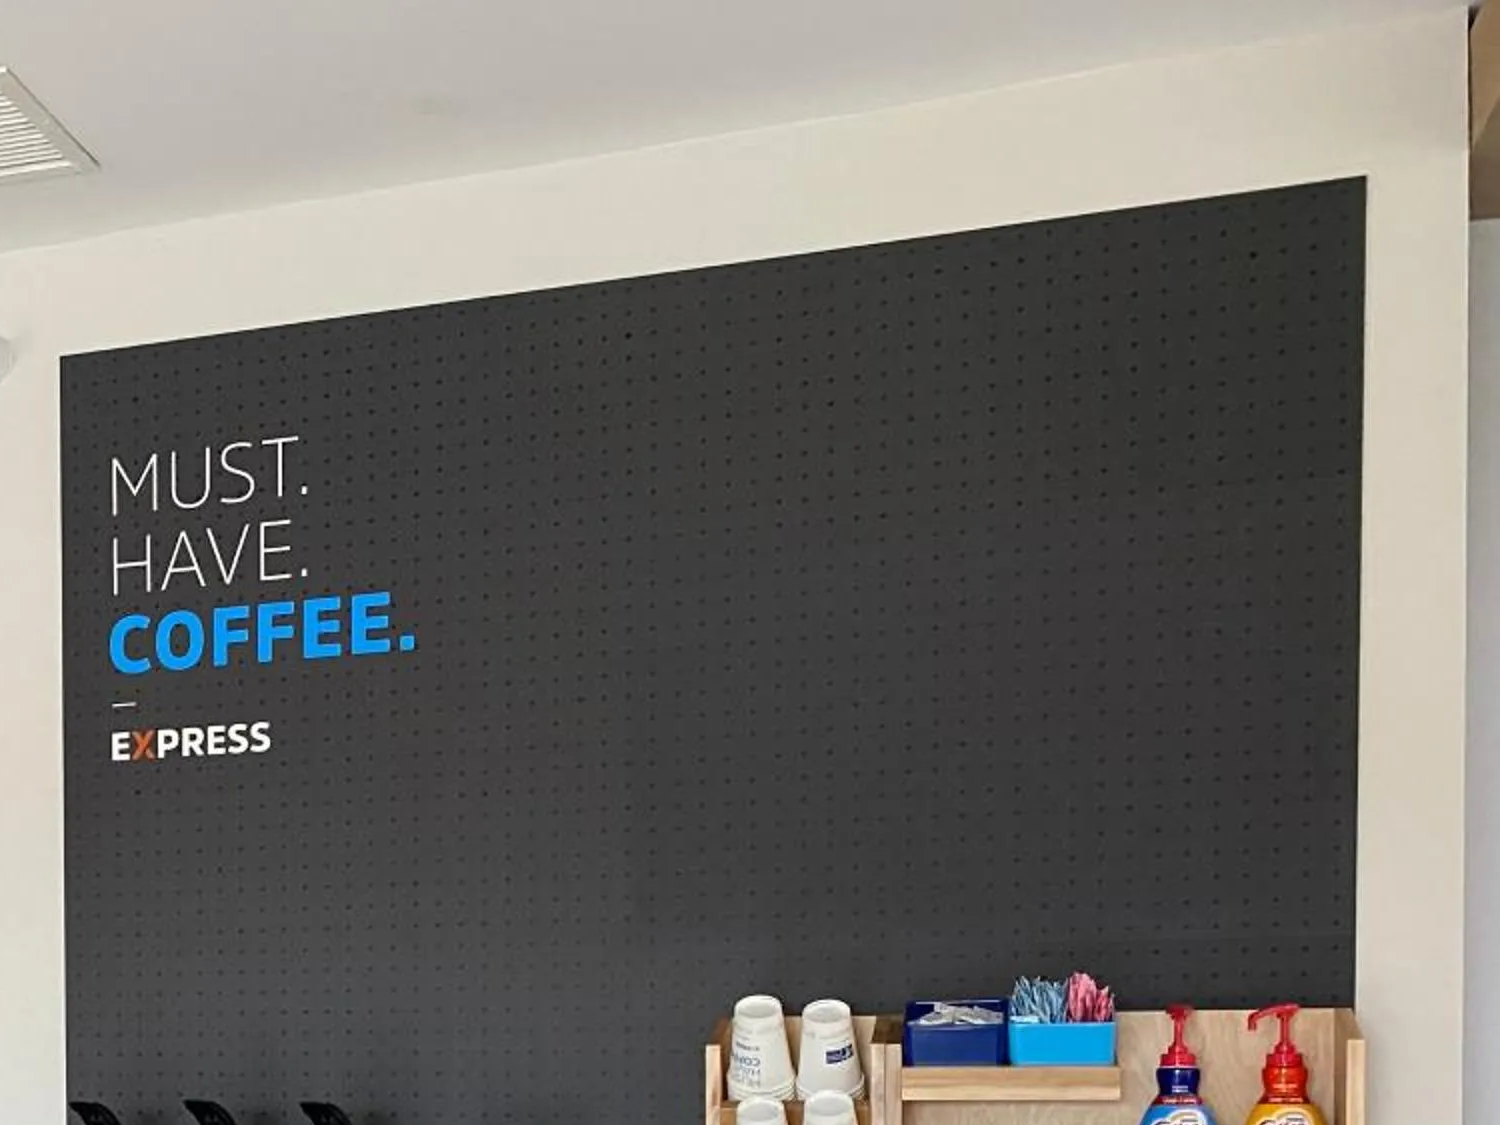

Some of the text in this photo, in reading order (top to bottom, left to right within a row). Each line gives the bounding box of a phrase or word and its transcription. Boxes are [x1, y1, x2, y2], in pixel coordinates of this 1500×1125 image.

[111, 436, 308, 516] MUST.
[112, 519, 308, 596] HAVE.
[109, 591, 416, 674] COFFEE.
[111, 722, 272, 761] EXPRESS
